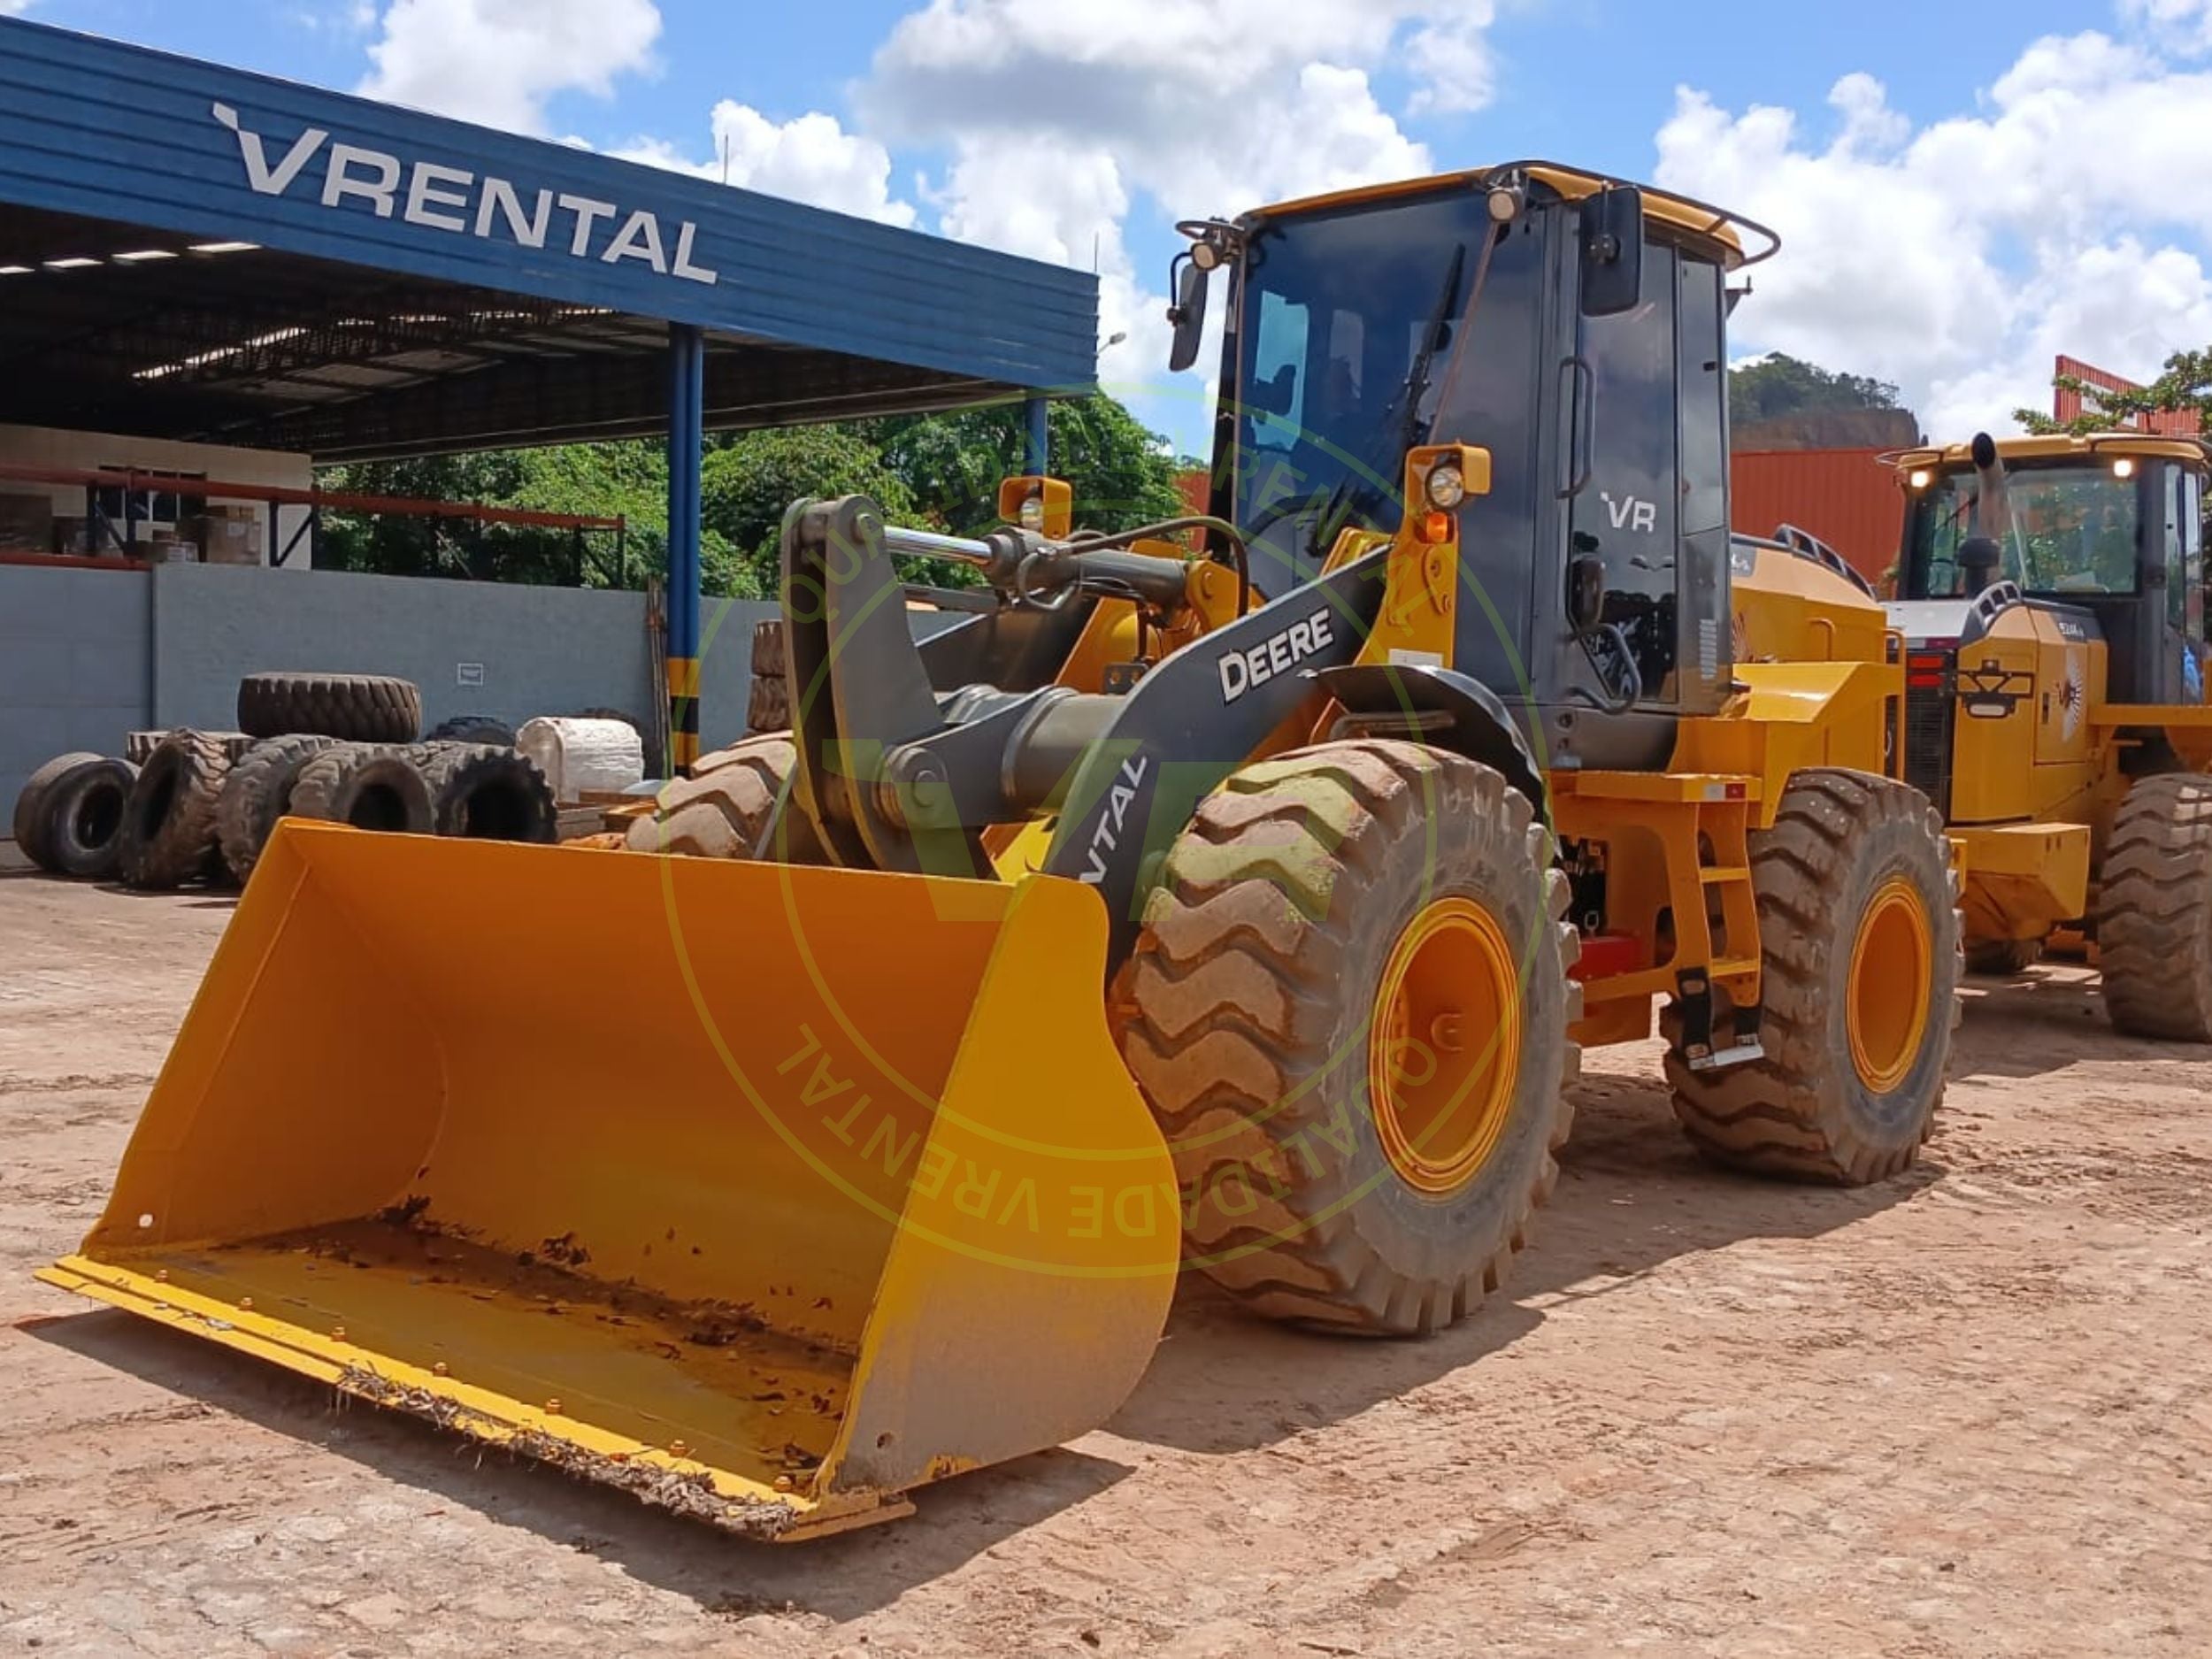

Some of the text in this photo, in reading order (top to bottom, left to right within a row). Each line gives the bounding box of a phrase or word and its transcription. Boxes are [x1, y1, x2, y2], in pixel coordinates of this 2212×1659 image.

[213, 102, 717, 284] VRENTAL
[1600, 492, 1655, 533] VR
[1217, 607, 1334, 703] DEERE
